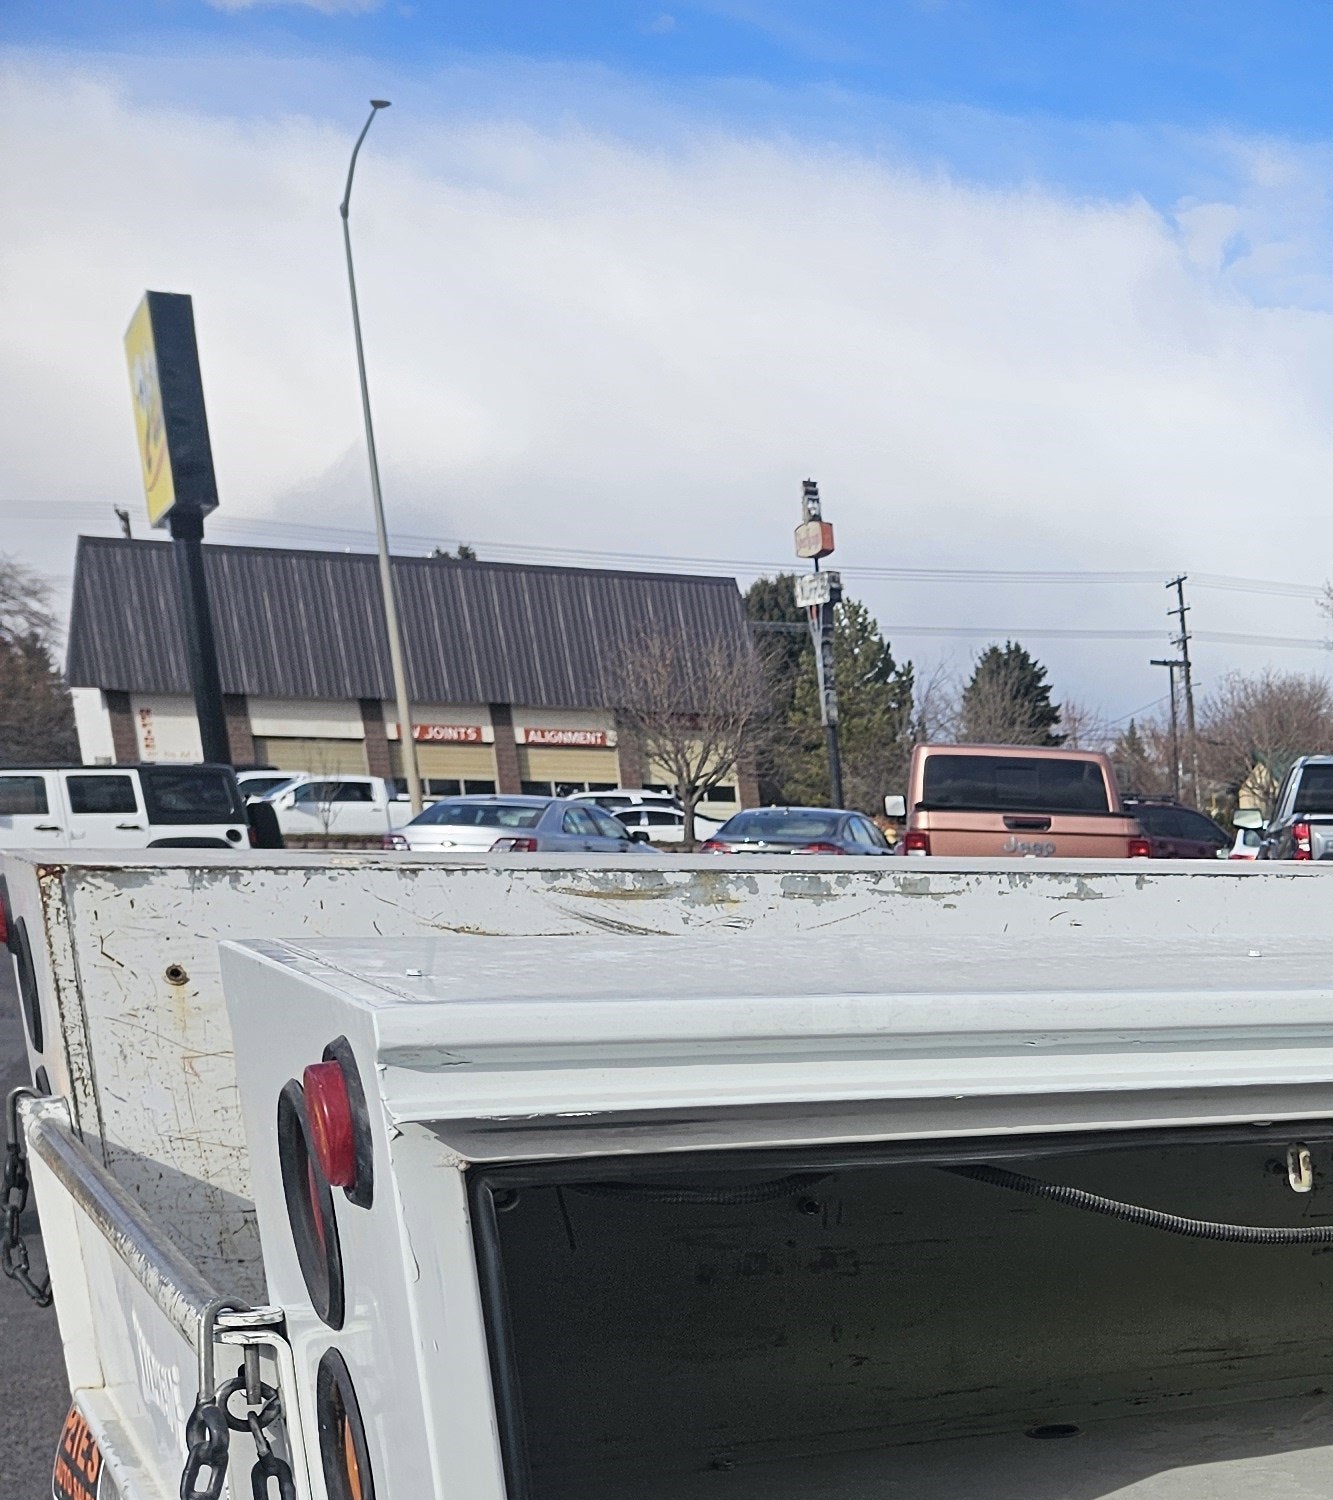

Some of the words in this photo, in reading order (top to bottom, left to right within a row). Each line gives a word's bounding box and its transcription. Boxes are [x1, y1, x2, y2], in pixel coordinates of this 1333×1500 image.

[423, 725, 478, 741] JOINTS
[528, 730, 603, 745] ALIGNMENT
[1003, 835, 1056, 857] Jeep
